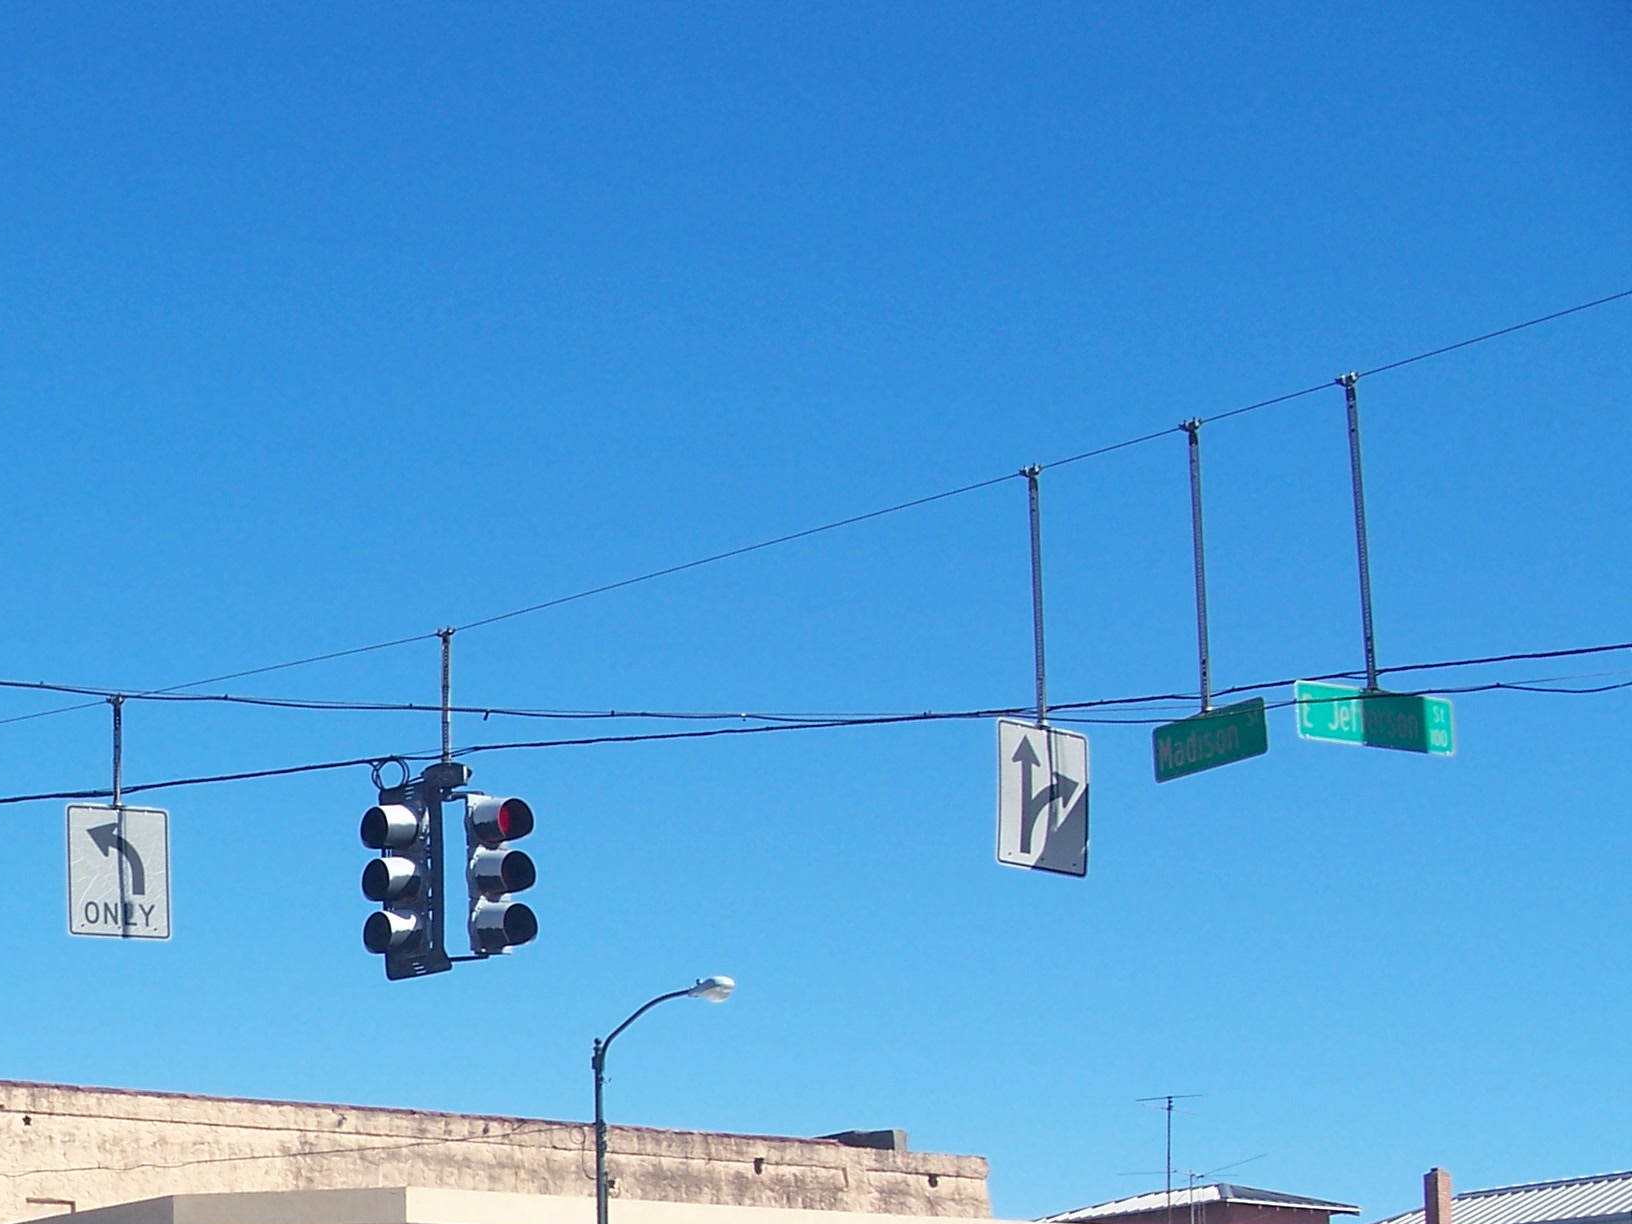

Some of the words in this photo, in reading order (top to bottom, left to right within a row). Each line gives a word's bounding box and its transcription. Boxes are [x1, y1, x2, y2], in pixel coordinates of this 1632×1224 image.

[1328, 697, 1417, 739] Jefferson
[1432, 704, 1446, 723] St
[1158, 723, 1241, 773] Madison
[84, 901, 155, 927] ONLY
